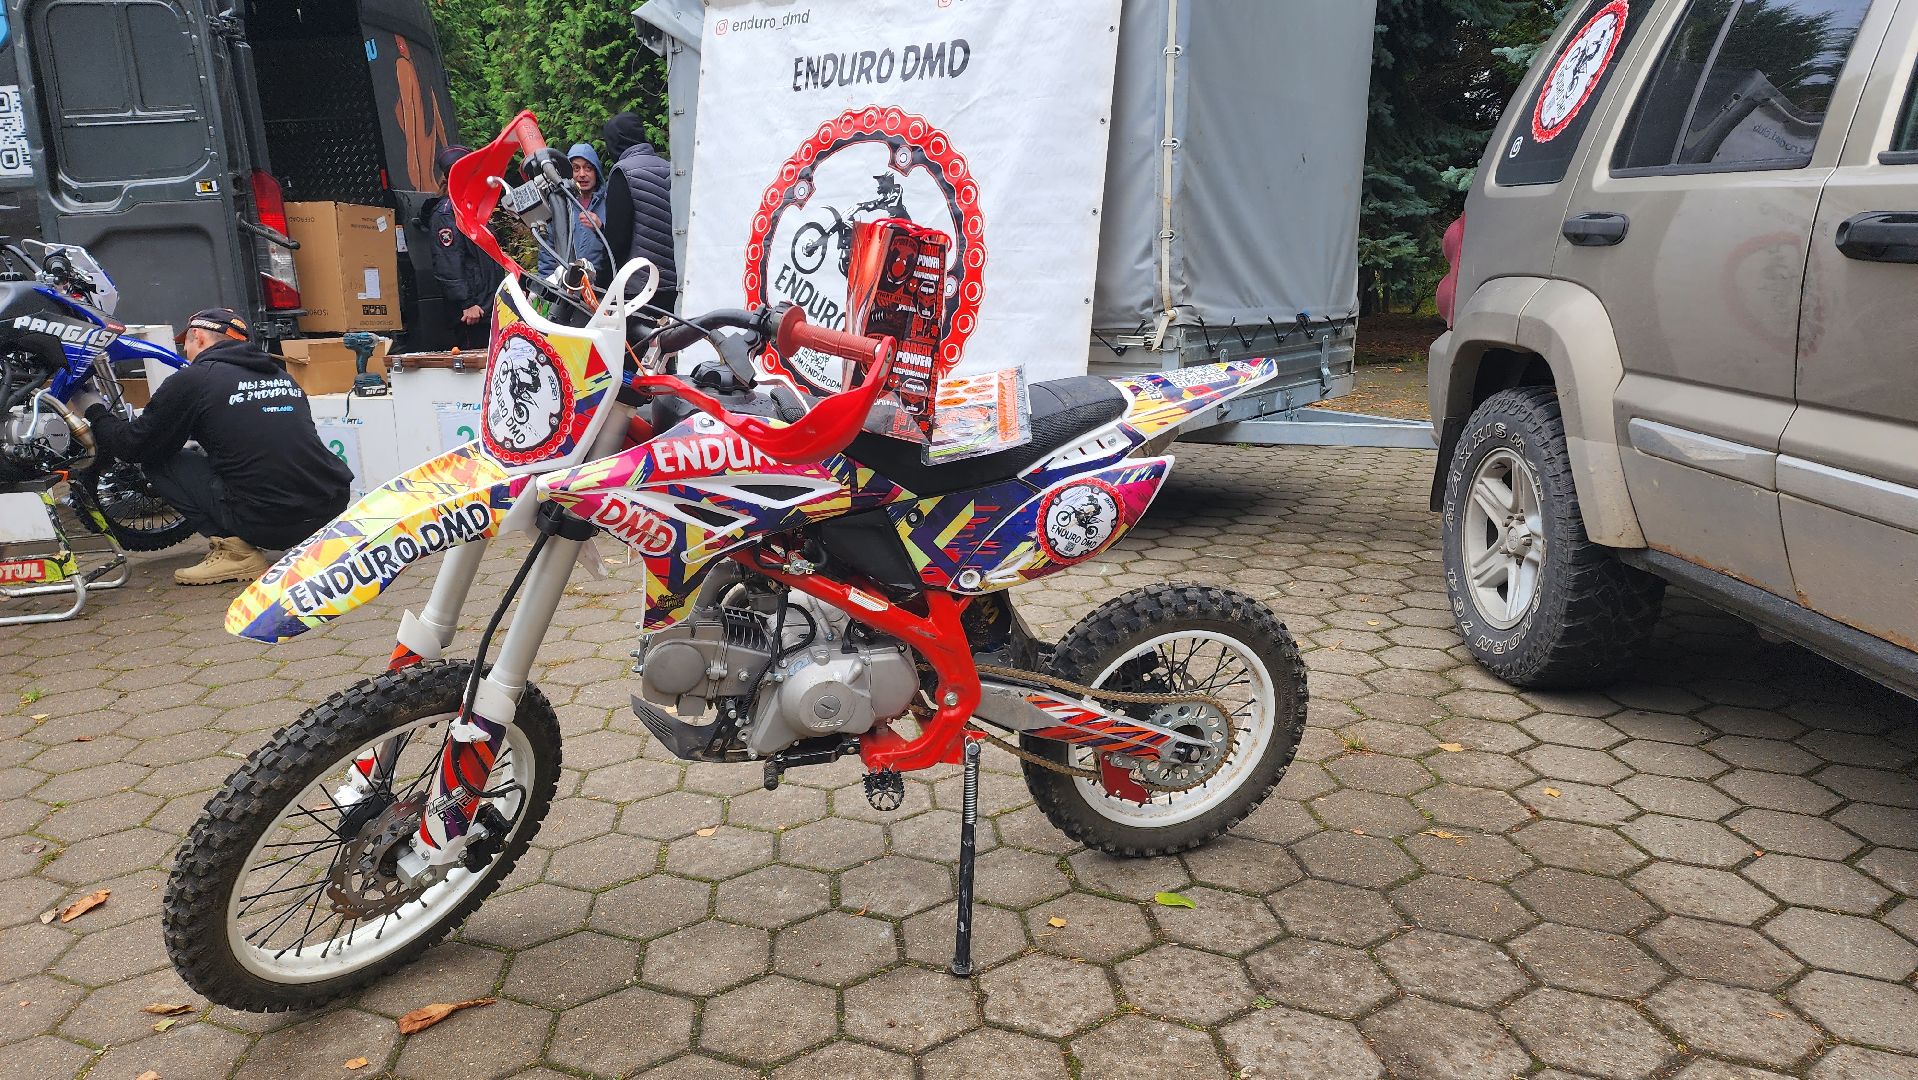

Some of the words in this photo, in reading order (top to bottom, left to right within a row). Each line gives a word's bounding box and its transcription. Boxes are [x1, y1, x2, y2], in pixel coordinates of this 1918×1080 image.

[732, 9, 810, 32] enduro_dmd
[792, 47, 895, 92] ENDURO
[900, 38, 970, 82] DMD
[895, 351, 932, 368] POWER
[506, 417, 526, 445] DMD
[653, 435, 795, 473] ENDUR
[597, 497, 674, 553] DMD
[1051, 524, 1081, 545] ENDURO
[1080, 536, 1097, 549] DMD
[0, 562, 42, 580] TUL
[287, 534, 421, 615] ENDURO
[420, 501, 490, 552] DMD
